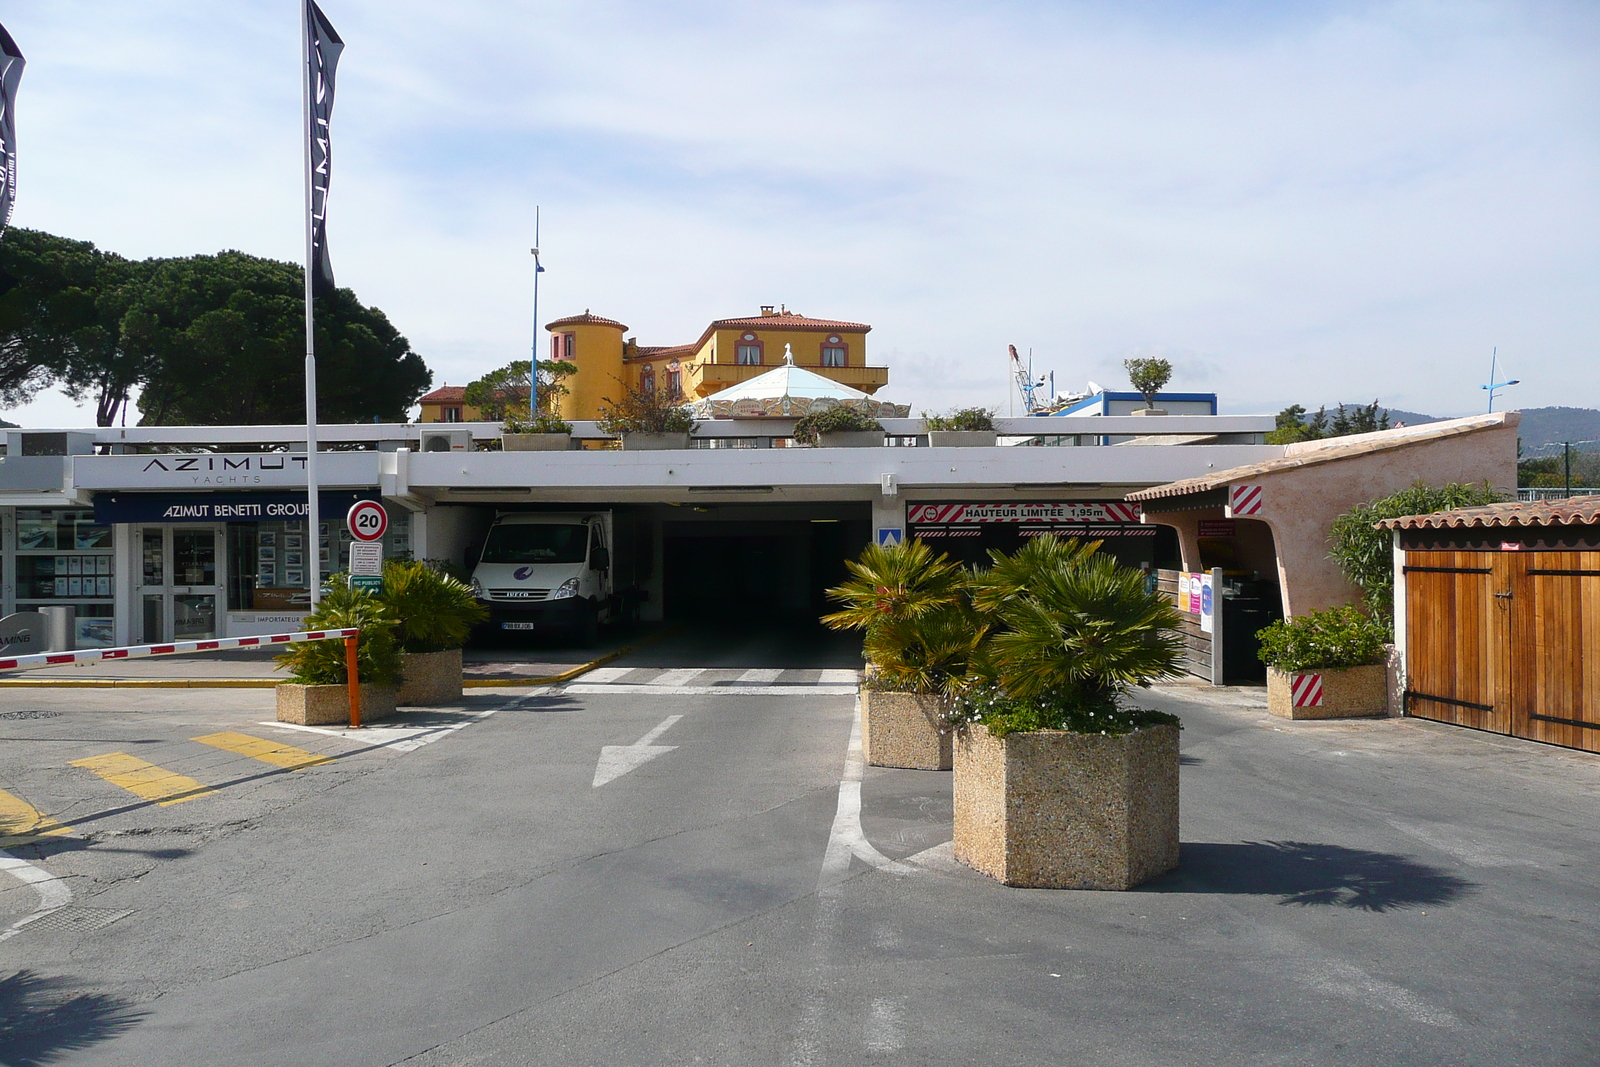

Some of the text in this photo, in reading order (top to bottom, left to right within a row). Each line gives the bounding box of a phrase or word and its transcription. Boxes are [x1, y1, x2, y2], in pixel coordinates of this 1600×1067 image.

[143, 456, 308, 472] AZIMUT
[192, 475, 261, 484] YACHTS
[162, 503, 310, 518] AZIMUT BENETTI GROUP
[965, 506, 1103, 518] HAUTEUR LIMITÉE 1,95m
[358, 514, 379, 528] 20
